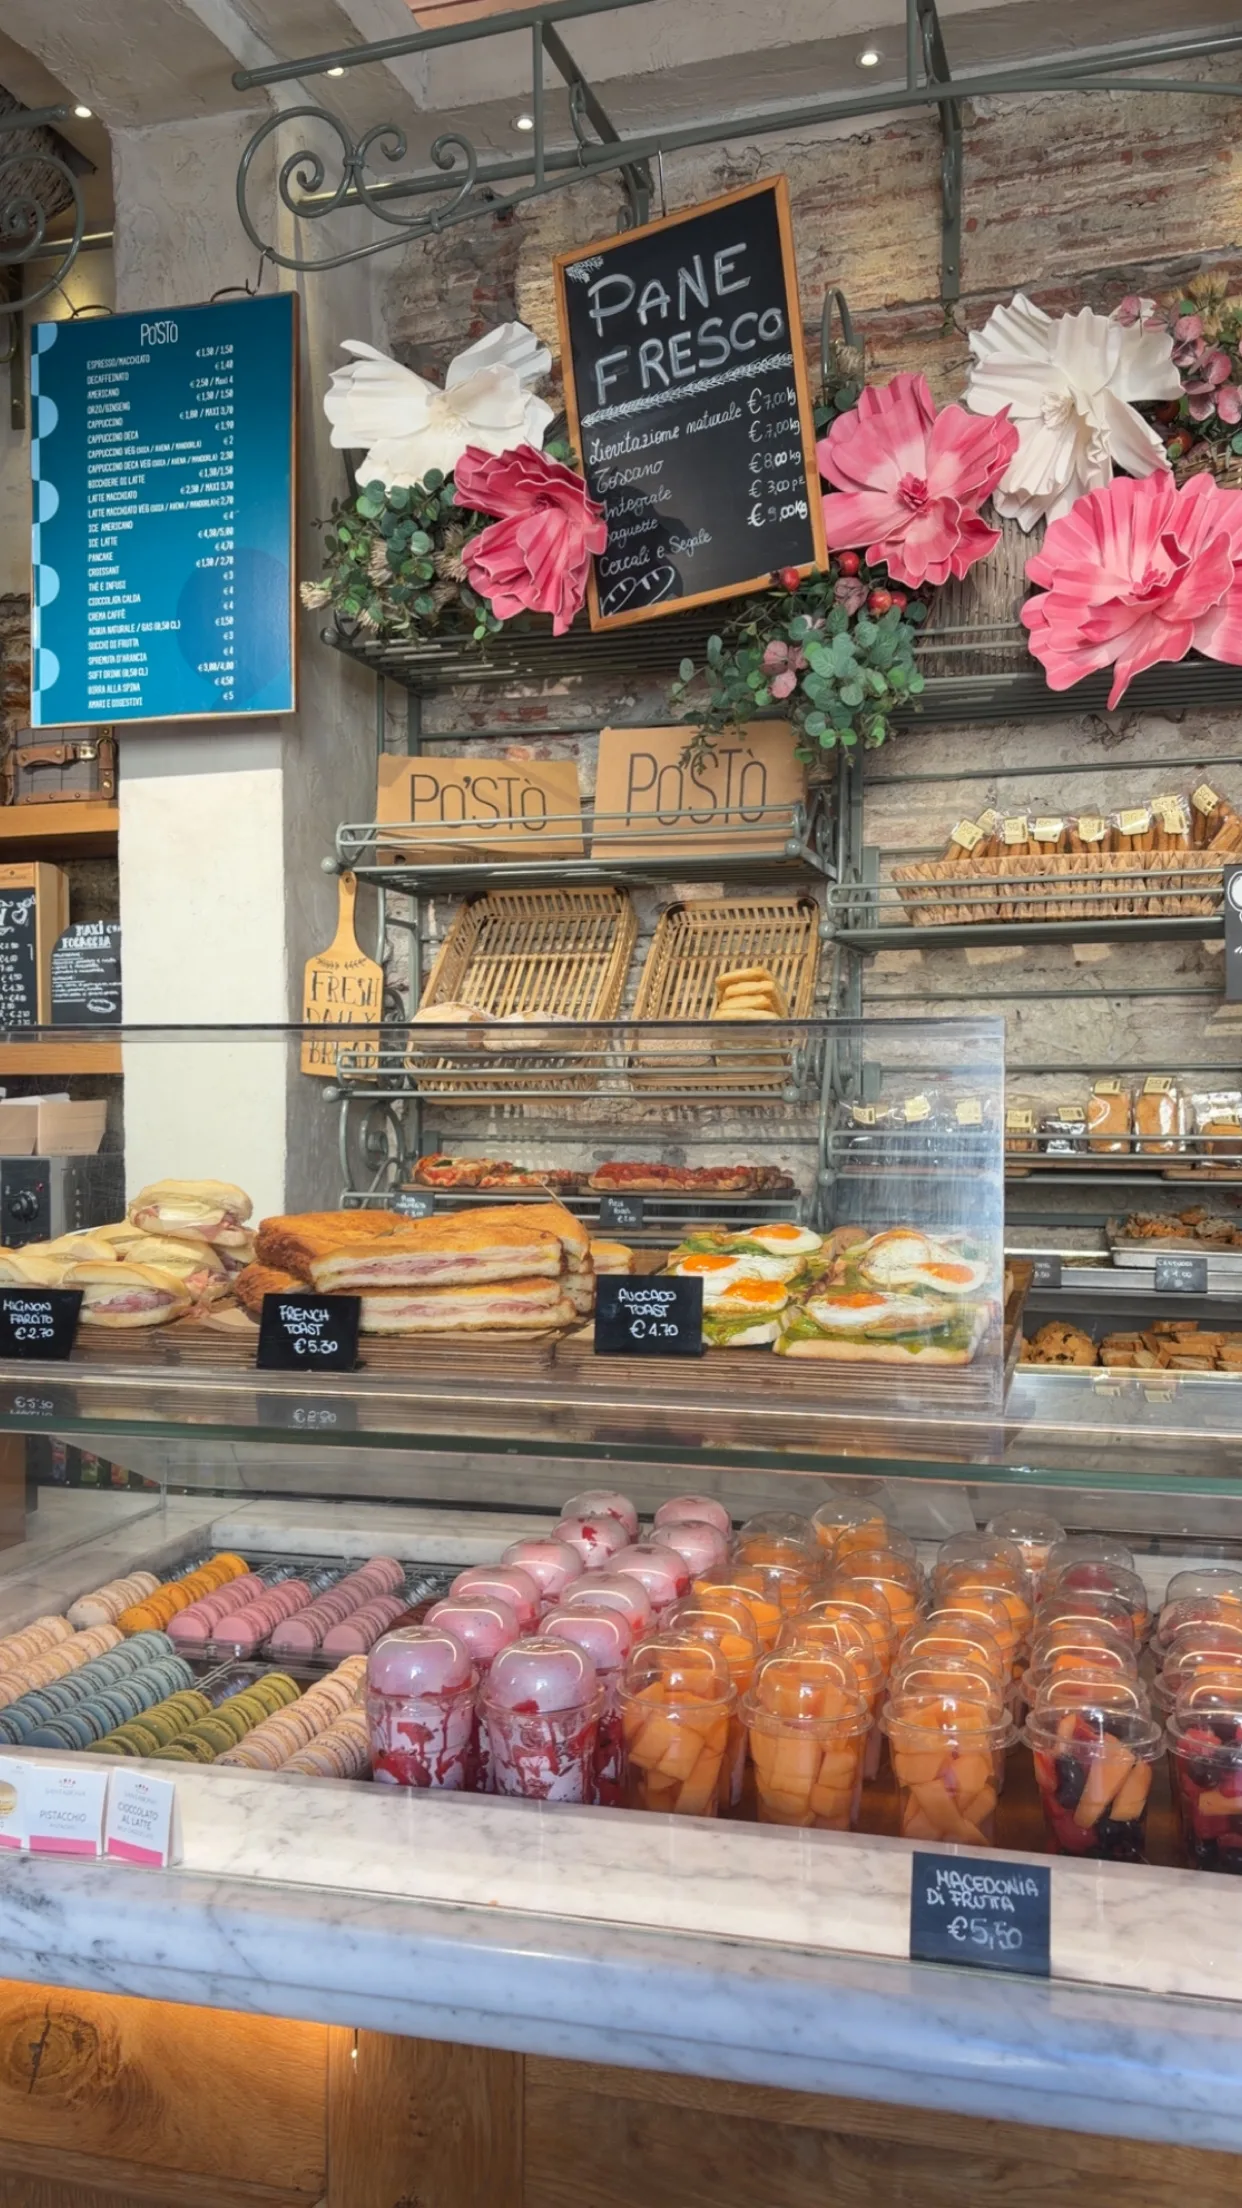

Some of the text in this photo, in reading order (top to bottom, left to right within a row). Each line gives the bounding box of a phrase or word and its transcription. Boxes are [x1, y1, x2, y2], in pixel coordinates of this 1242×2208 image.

[588, 243, 752, 337] PANE
[595, 308, 784, 405] FRESCO
[87, 387, 120, 399] AMERICANO
[87, 418, 123, 429] CAPPUCCINO
[686, 401, 743, 434] naturale
[87, 430, 139, 444] CAPPUCCINO DECA
[88, 447, 123, 459] CAPPUCCINO
[88, 462, 123, 474] CAPPUCCINO
[124, 460, 139, 470] DECA
[128, 474, 146, 485] LATTE
[594, 459, 664, 494] Toscano
[88, 490, 137, 503] LATTE MACCHIATO
[88, 508, 105, 519] LATTE
[106, 504, 138, 517] MACCHIATO
[88, 520, 133, 533] ICE AMERICANO
[607, 517, 658, 549] aguette
[88, 536, 118, 548] ICE LATTE
[88, 551, 113, 562] PANCAKE
[599, 527, 712, 578] Cereali e Segale
[88, 566, 120, 578] CROISSANT
[88, 593, 141, 606] CIOCCOLATA CALDA
[107, 623, 136, 634] NATURALE
[118, 638, 139, 648] FRUTTA
[88, 670, 102, 680] SOFT
[106, 684, 121, 694] ALLA
[312, 970, 381, 1008] FRESH
[618, 1288, 677, 1303] AVOCADO
[278, 1304, 330, 1322] FRENCH
[624, 1304, 670, 1318] TOAST
[283, 1322, 324, 1336] TOAST
[39, 1810, 87, 1822] PISTACCHIO
[117, 1801, 158, 1821] CIOCCOLATO
[936, 1869, 1040, 1897] MACEDONIA
[948, 1890, 1015, 1912] FRUTTA
